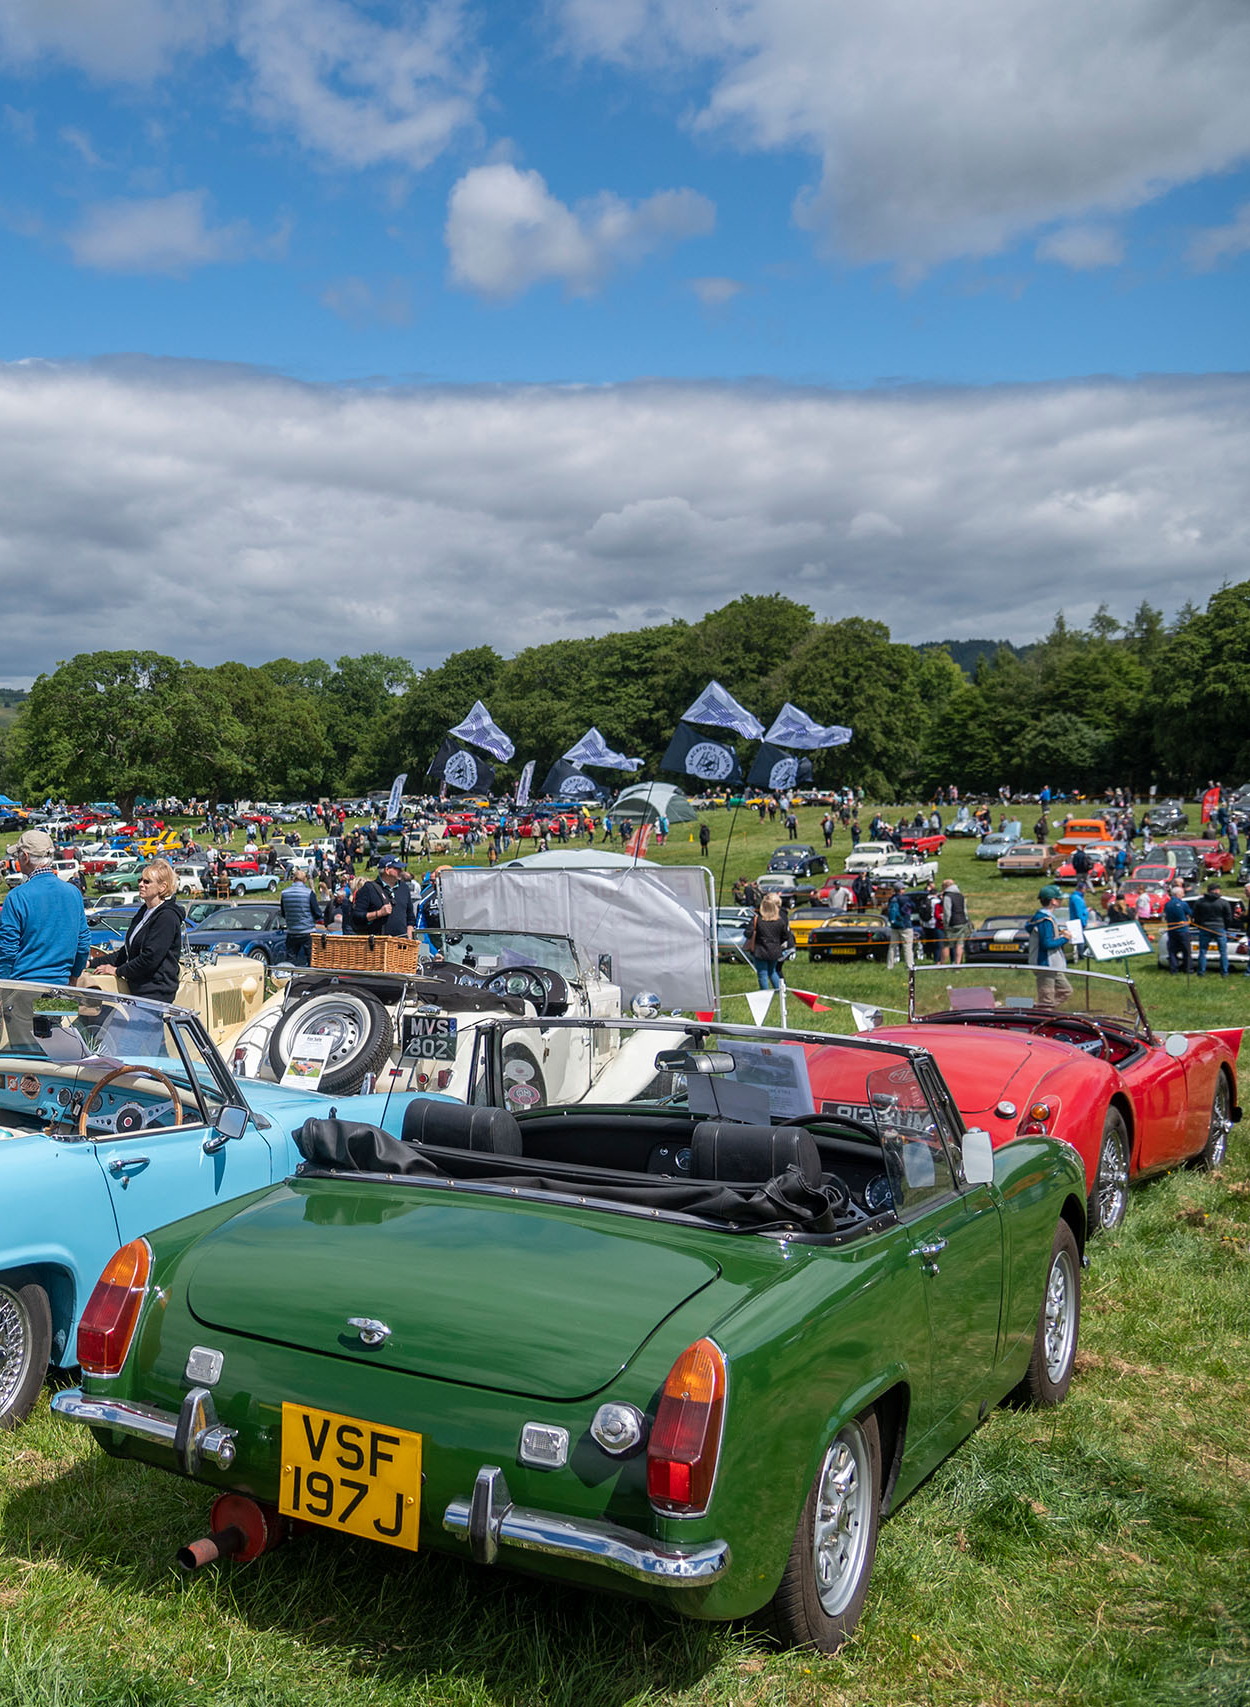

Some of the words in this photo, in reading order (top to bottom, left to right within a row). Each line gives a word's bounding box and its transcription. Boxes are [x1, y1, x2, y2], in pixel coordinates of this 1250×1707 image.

[1101, 939, 1136, 950] Classic
[1108, 946, 1136, 956] Youth
[410, 1018, 449, 1038] MVS
[409, 1038, 448, 1058] 802
[302, 1414, 401, 1477] VSF
[292, 1465, 404, 1537] 197J
